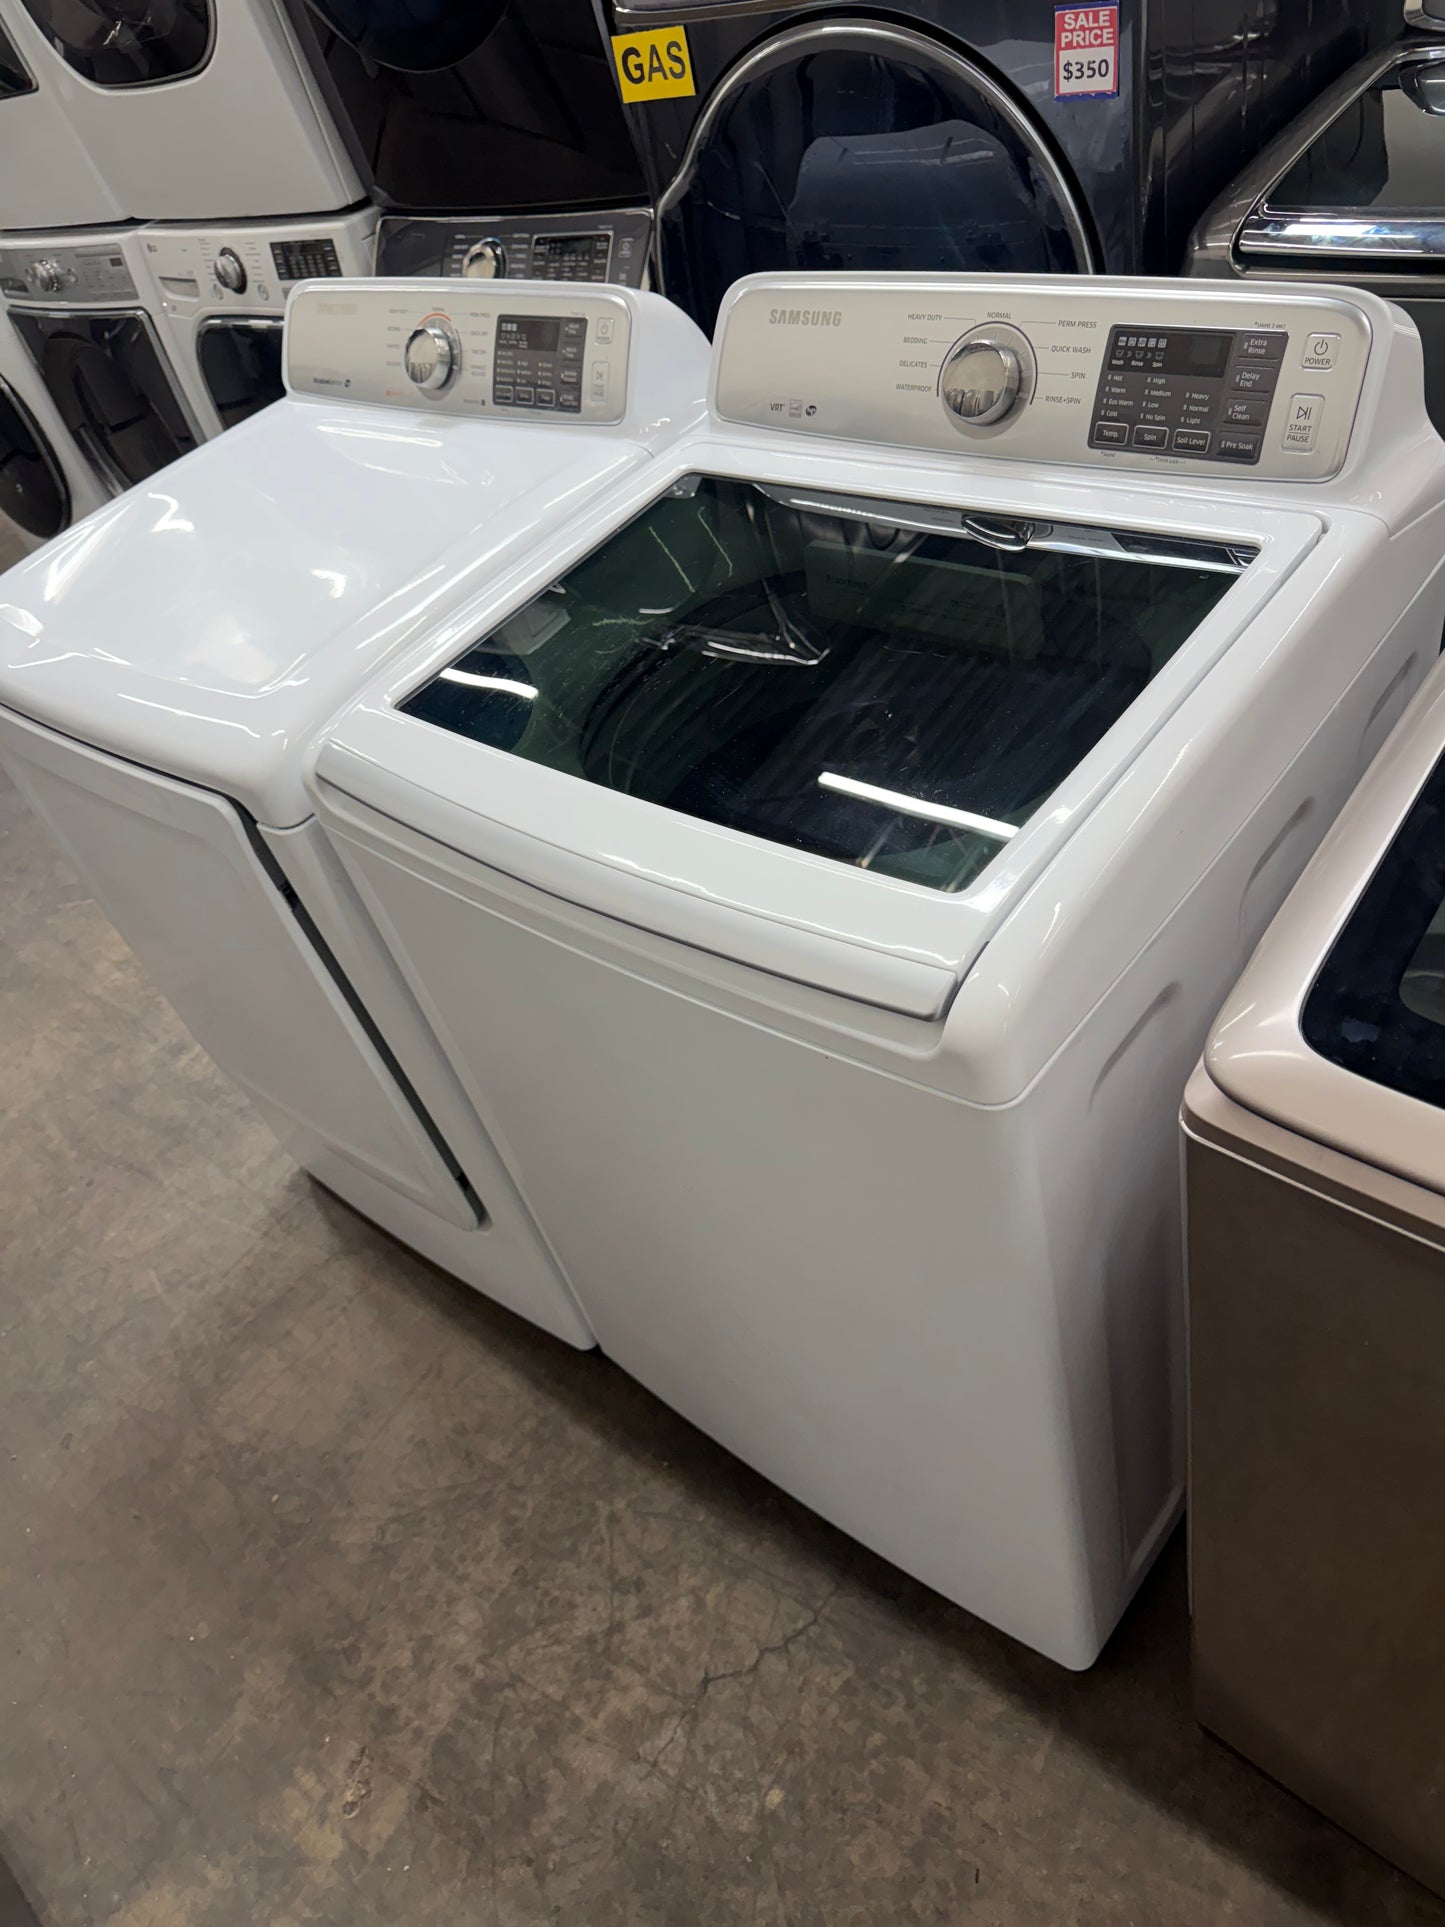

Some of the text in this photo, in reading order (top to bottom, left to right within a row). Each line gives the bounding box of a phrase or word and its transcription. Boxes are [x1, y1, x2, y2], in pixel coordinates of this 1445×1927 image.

[1064, 11, 1110, 29] SALE
[1061, 28, 1114, 48] PRICE
[621, 40, 686, 85] GAS
[1063, 59, 1109, 82] $350
[769, 309, 842, 327] SAMSUNG
[907, 313, 926, 321] HEAVY
[986, 311, 1012, 320] NORMAL
[1058, 320, 1076, 328] PERM
[903, 336, 928, 345] BEDDING
[1250, 338, 1268, 347] Extra
[1050, 345, 1091, 354] QUICK WASH
[1248, 347, 1266, 355] Rinse
[899, 360, 928, 369] DELICATES
[1304, 357, 1331, 365] POWER
[1071, 371, 1086, 379] SPIN
[1241, 371, 1261, 381] Delay
[1152, 377, 1166, 385] High
[1240, 380, 1253, 388] End
[895, 383, 932, 393] WATERPROOF
[1045, 395, 1081, 405] RINSE+SPIN
[1191, 392, 1210, 401] Heavy
[1119, 399, 1134, 407] Warm
[1233, 404, 1247, 412] Self
[1232, 412, 1250, 420] Clean
[1186, 417, 1201, 425] Light
[1288, 424, 1312, 432] START
[1189, 438, 1206, 446] Level
[1286, 434, 1310, 443] PAUSE
[1225, 441, 1237, 449] Pre
